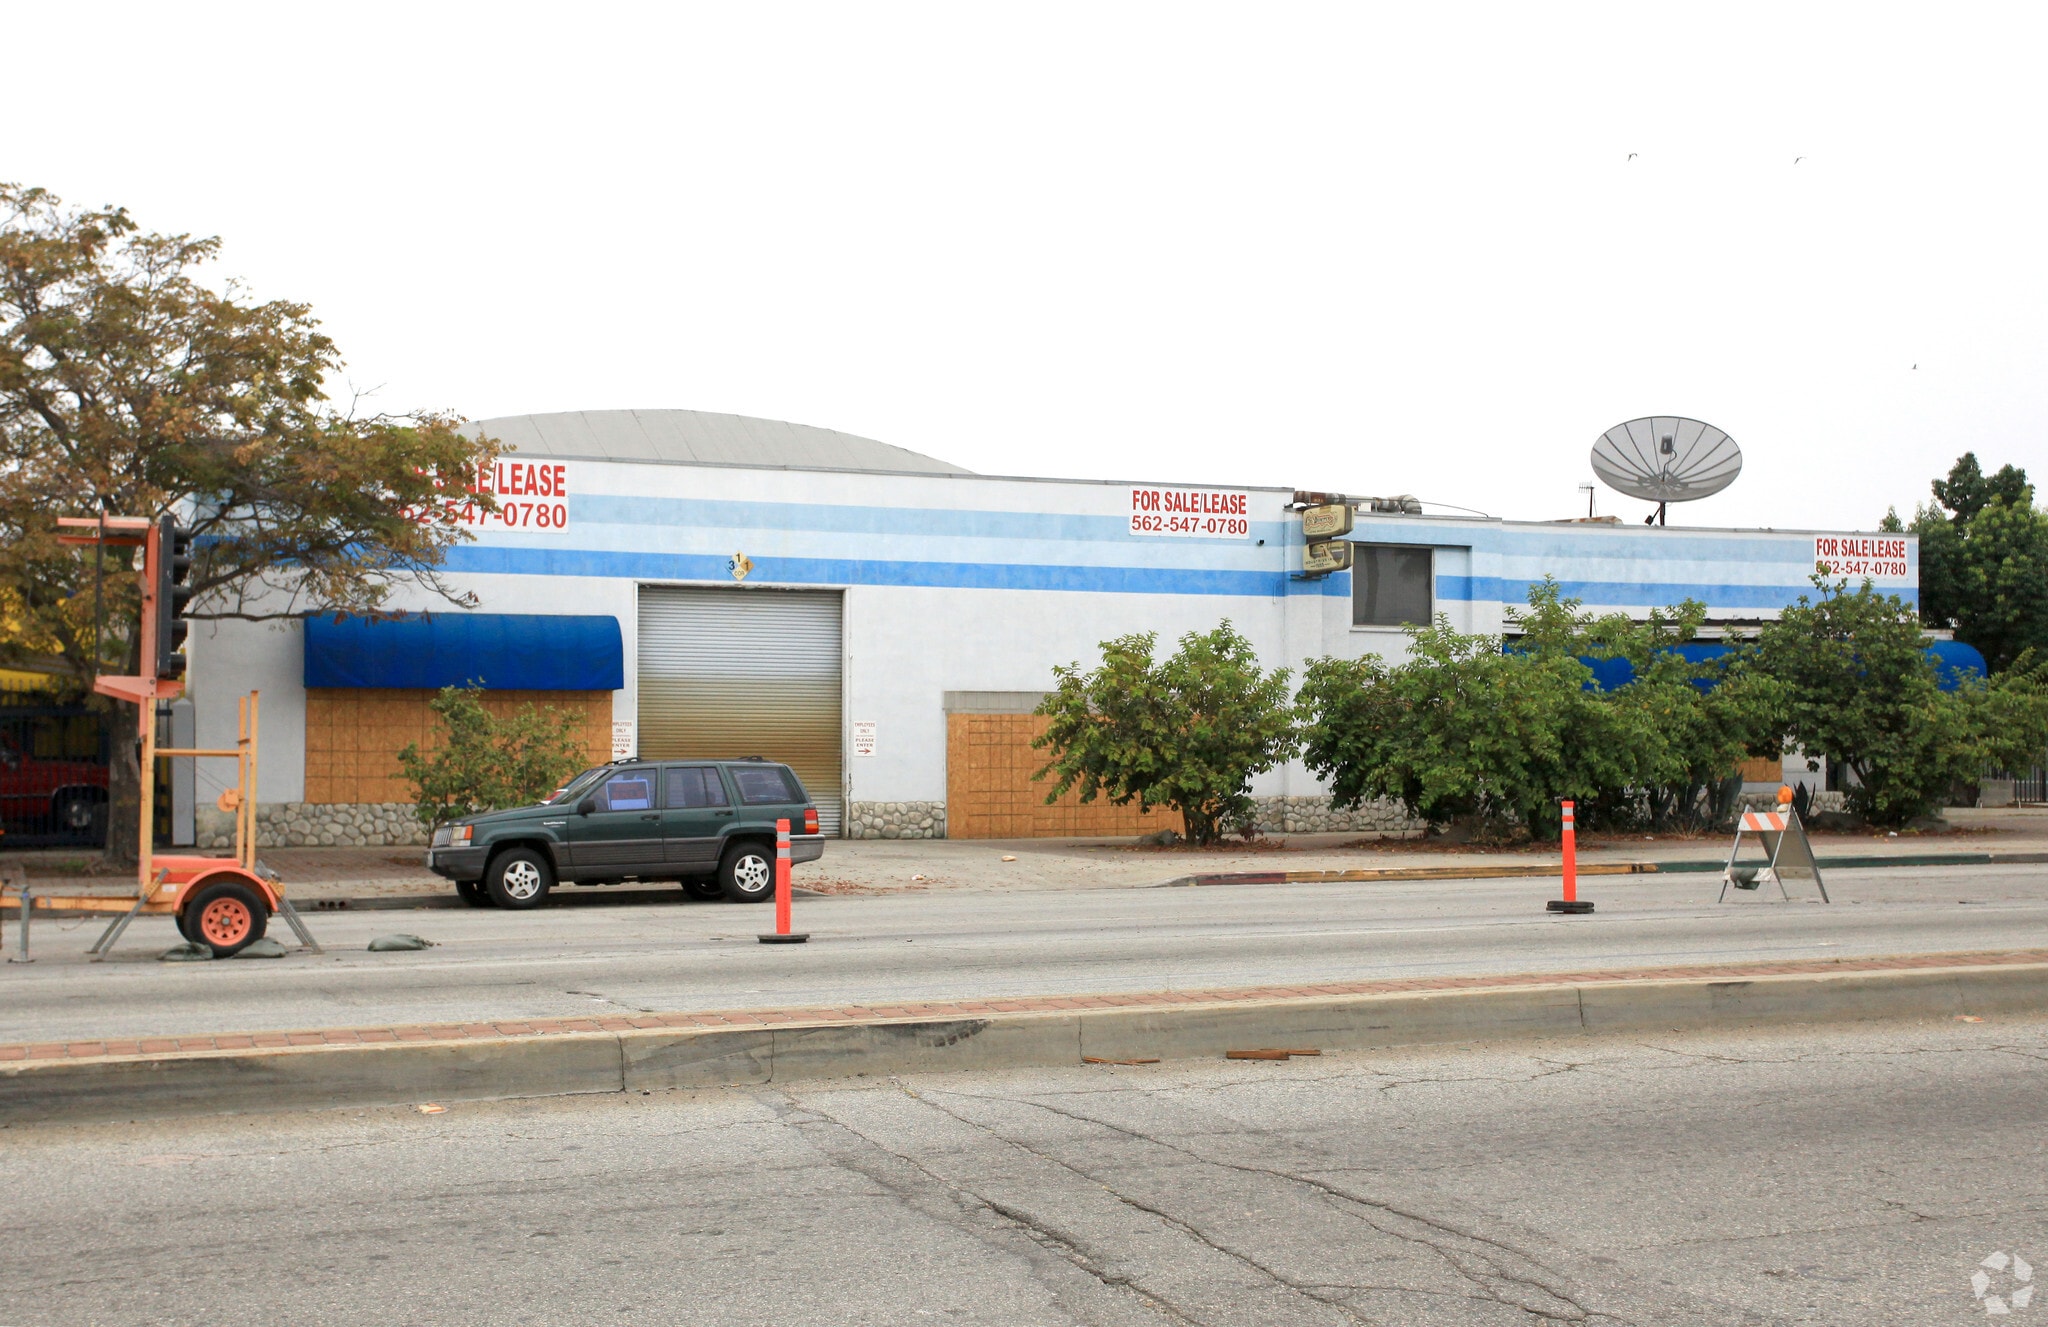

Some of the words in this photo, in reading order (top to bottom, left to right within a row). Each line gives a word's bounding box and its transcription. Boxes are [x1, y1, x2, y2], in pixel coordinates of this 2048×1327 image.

[434, 461, 566, 498] LE/LEASE
[1132, 490, 1160, 511] FOR
[1164, 491, 1247, 515] SALE/LEASE
[394, 500, 567, 529] 62-547-0780
[1131, 515, 1248, 535] 562-547-0780
[735, 552, 741, 563] 1
[1816, 538, 1838, 556] FOR
[1841, 538, 1906, 558] SALE/LEASE
[728, 560, 736, 570] 3
[744, 561, 749, 571] 1
